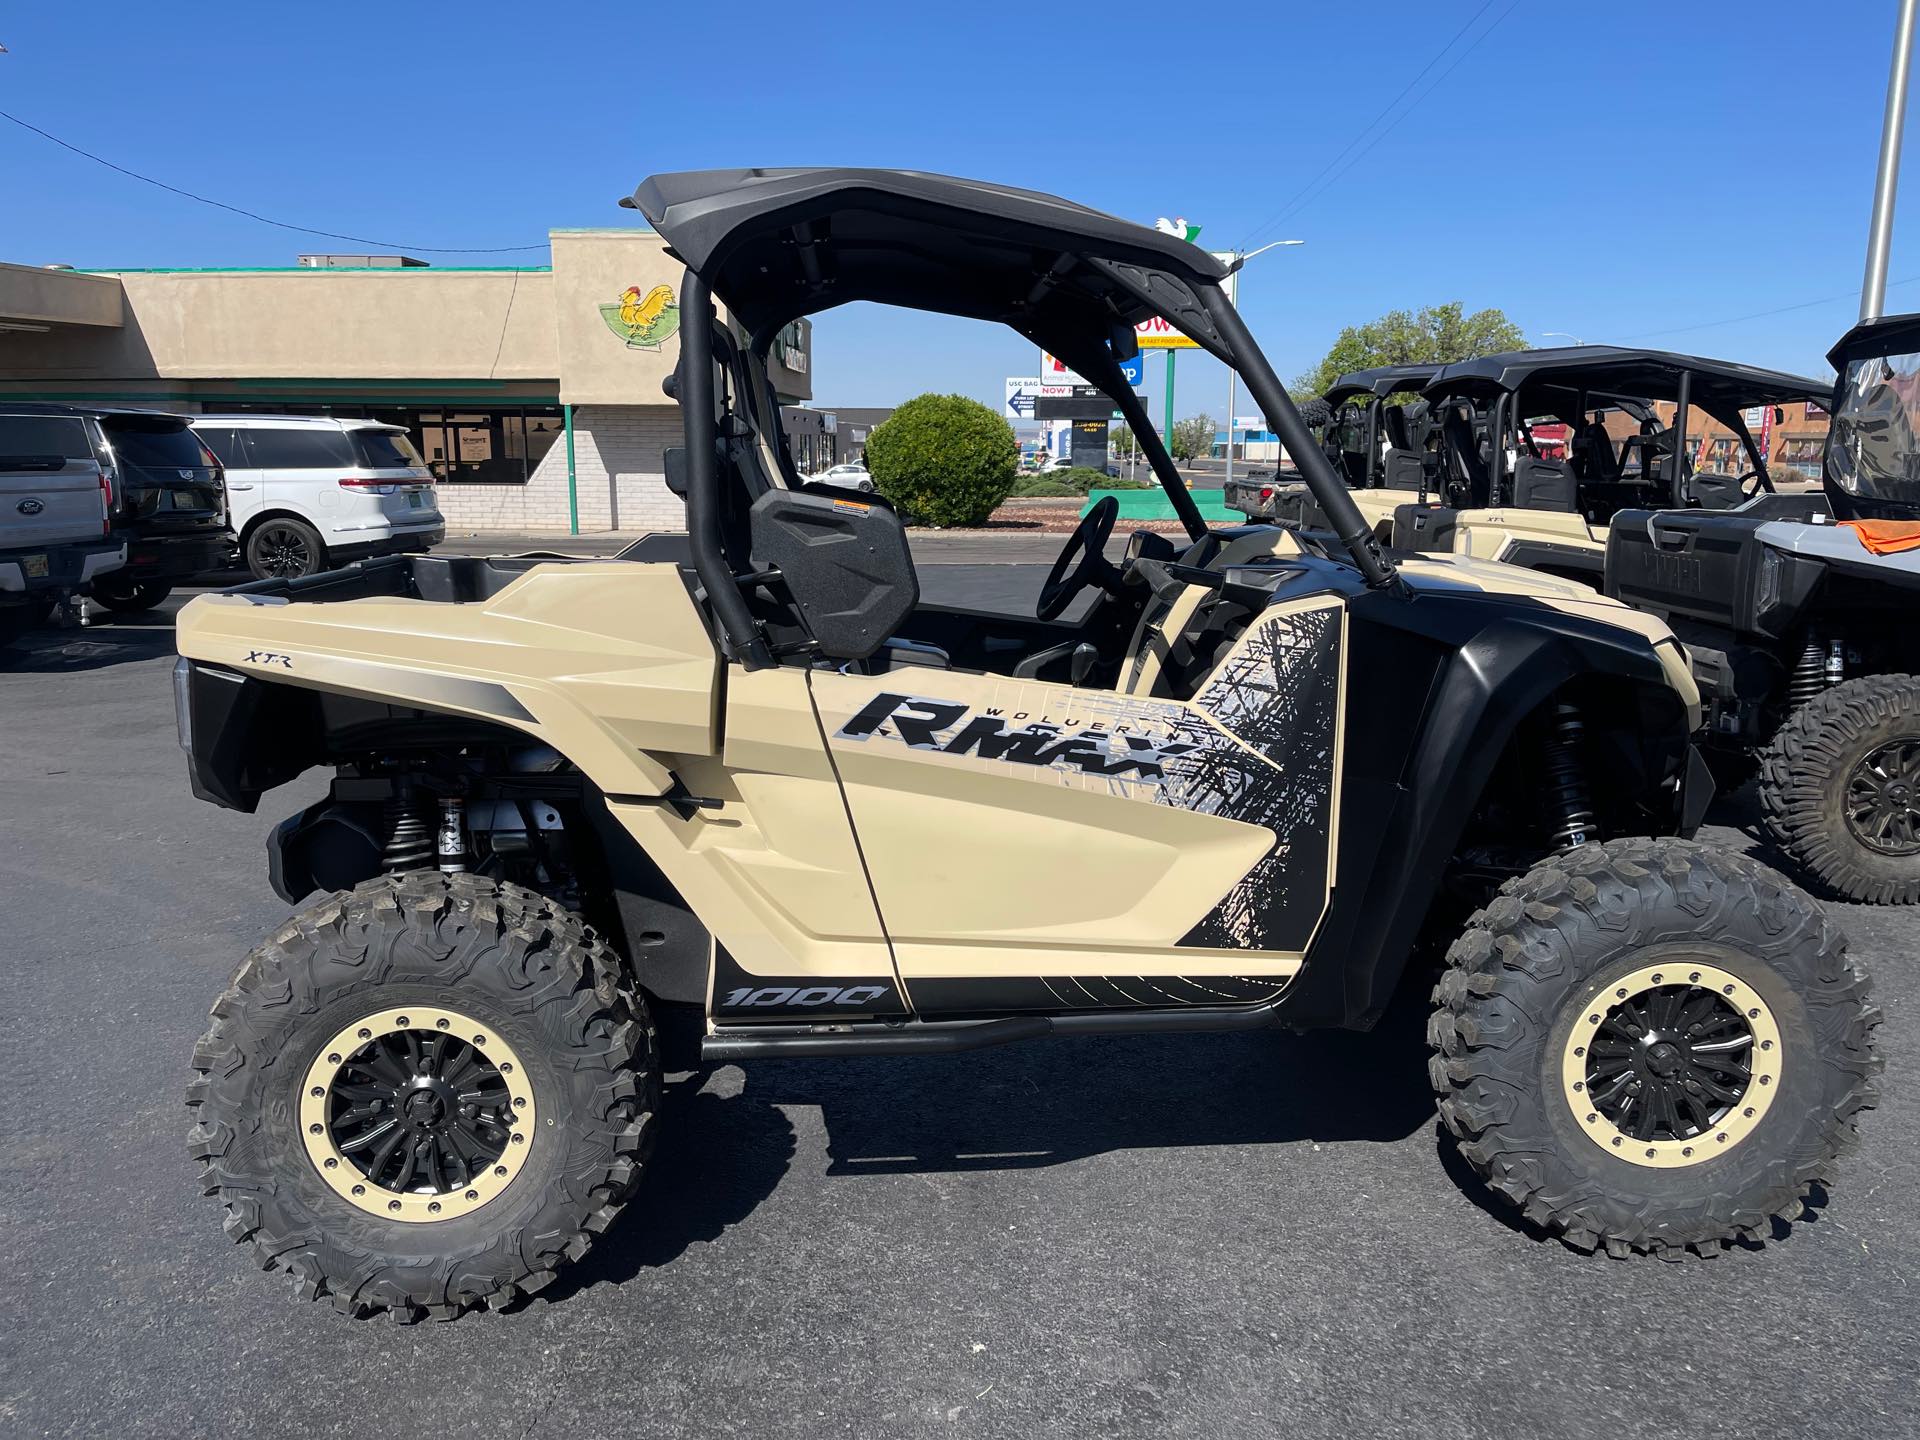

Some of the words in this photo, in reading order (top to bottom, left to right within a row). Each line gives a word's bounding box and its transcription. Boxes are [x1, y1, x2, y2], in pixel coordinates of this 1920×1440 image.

[1041, 387, 1066, 395] NOW
[242, 651, 293, 669] XTR
[833, 689, 1203, 782] RMAX
[986, 707, 1206, 744] WOLVERINE
[722, 986, 890, 1006] 1000
